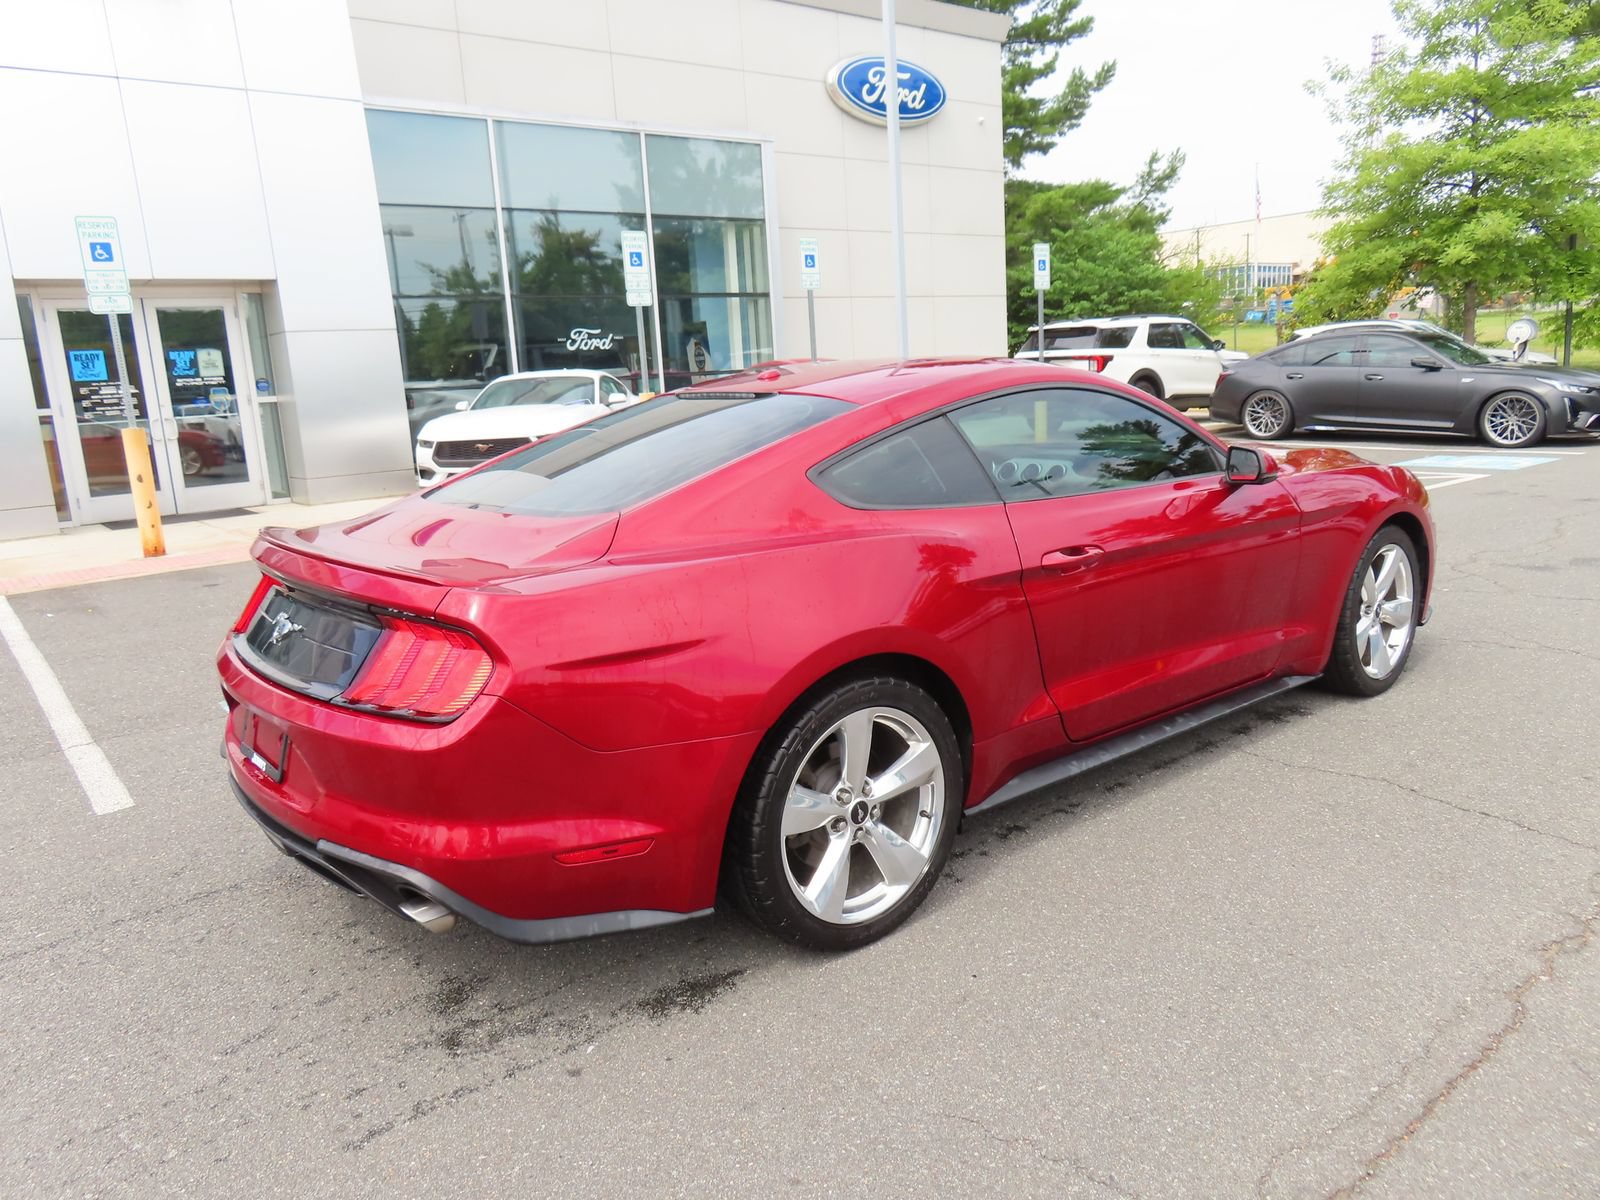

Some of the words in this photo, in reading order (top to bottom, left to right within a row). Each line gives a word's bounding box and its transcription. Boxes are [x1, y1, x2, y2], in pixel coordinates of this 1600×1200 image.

[862, 66, 927, 110] Frd
[78, 221, 116, 229] RESERVED
[566, 328, 613, 351] Ford
[73, 353, 100, 361] READY
[80, 361, 96, 369] SET
